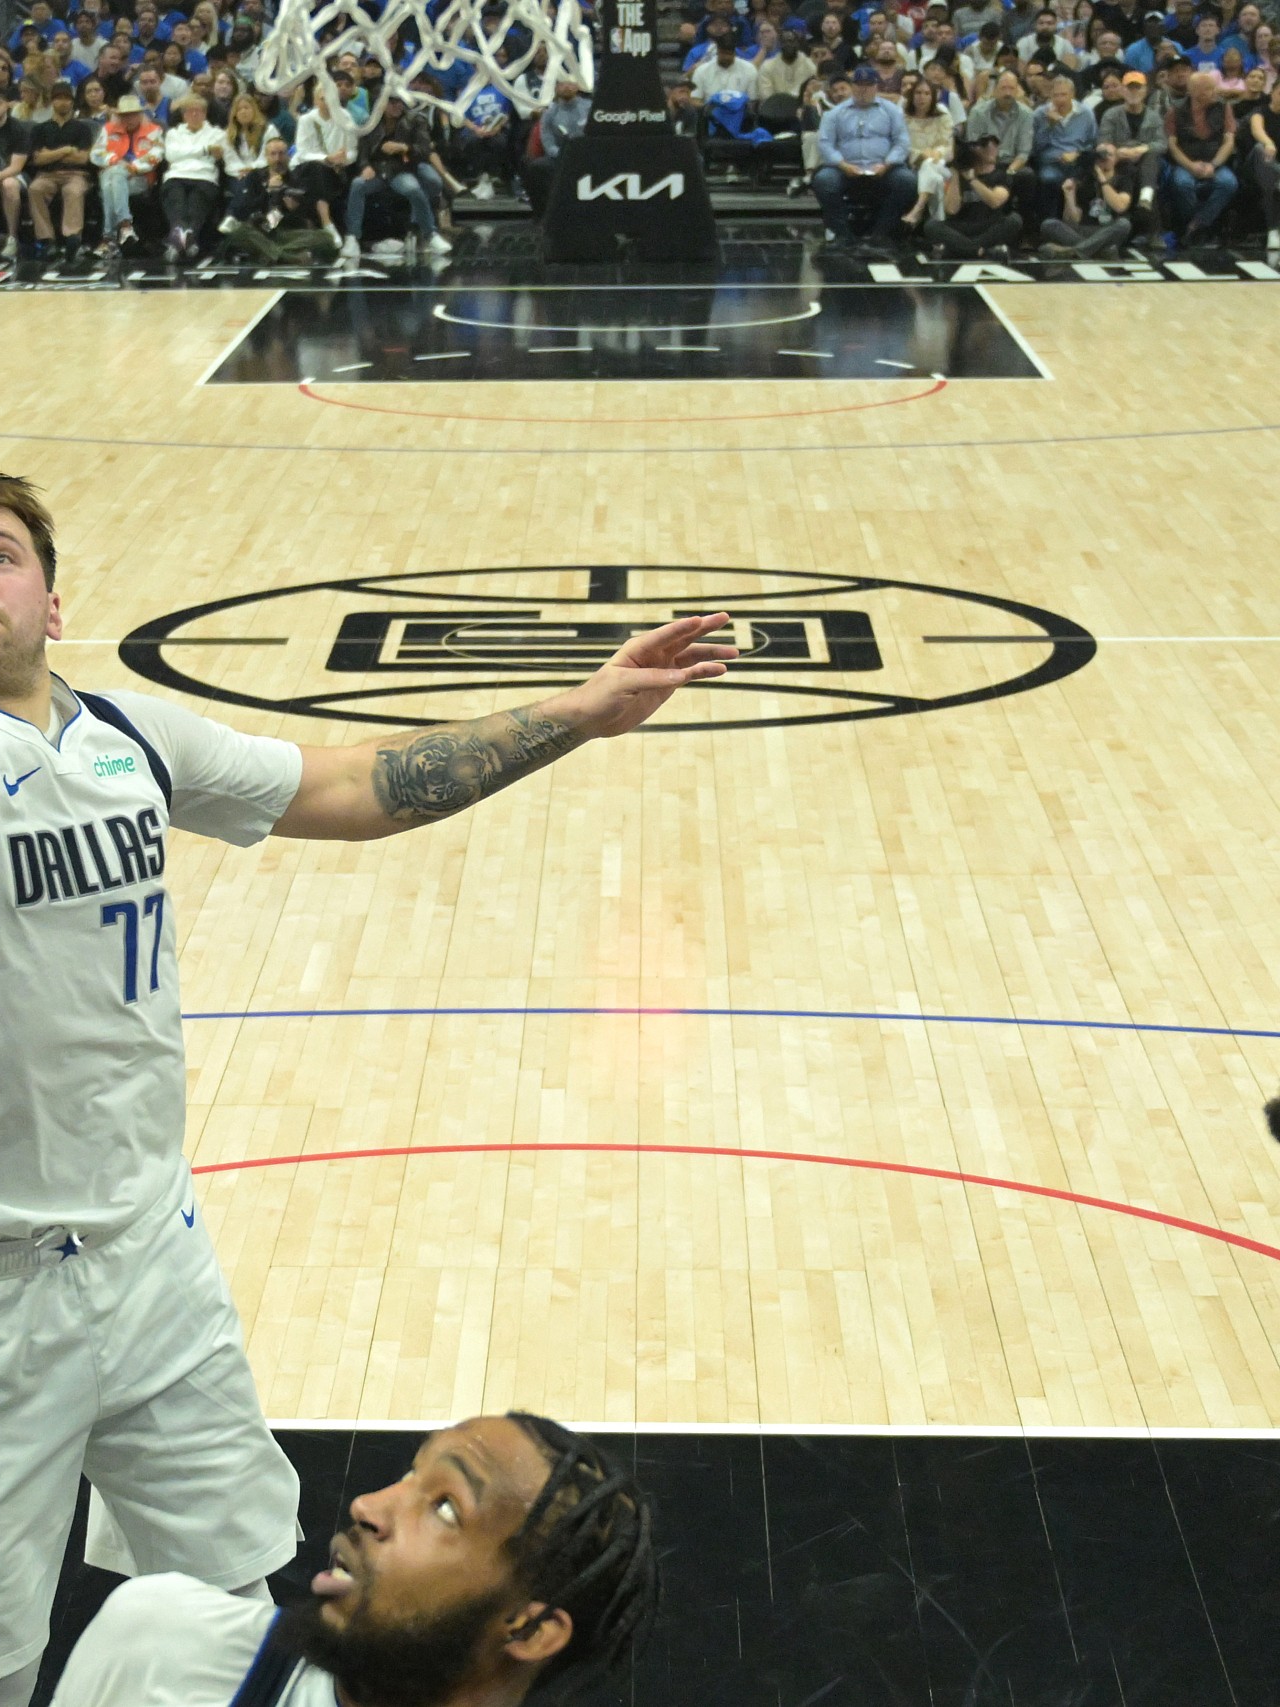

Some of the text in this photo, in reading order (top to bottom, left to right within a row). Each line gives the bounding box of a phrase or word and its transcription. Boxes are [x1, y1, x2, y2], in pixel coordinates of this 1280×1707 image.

[617, 3, 644, 26] THE
[623, 28, 651, 57] App
[593, 110, 666, 125] Google Pixel
[867, 262, 1036, 282] LA
[93, 755, 136, 777] chime
[7, 807, 166, 908] DALLAS
[100, 892, 166, 1006] 77
